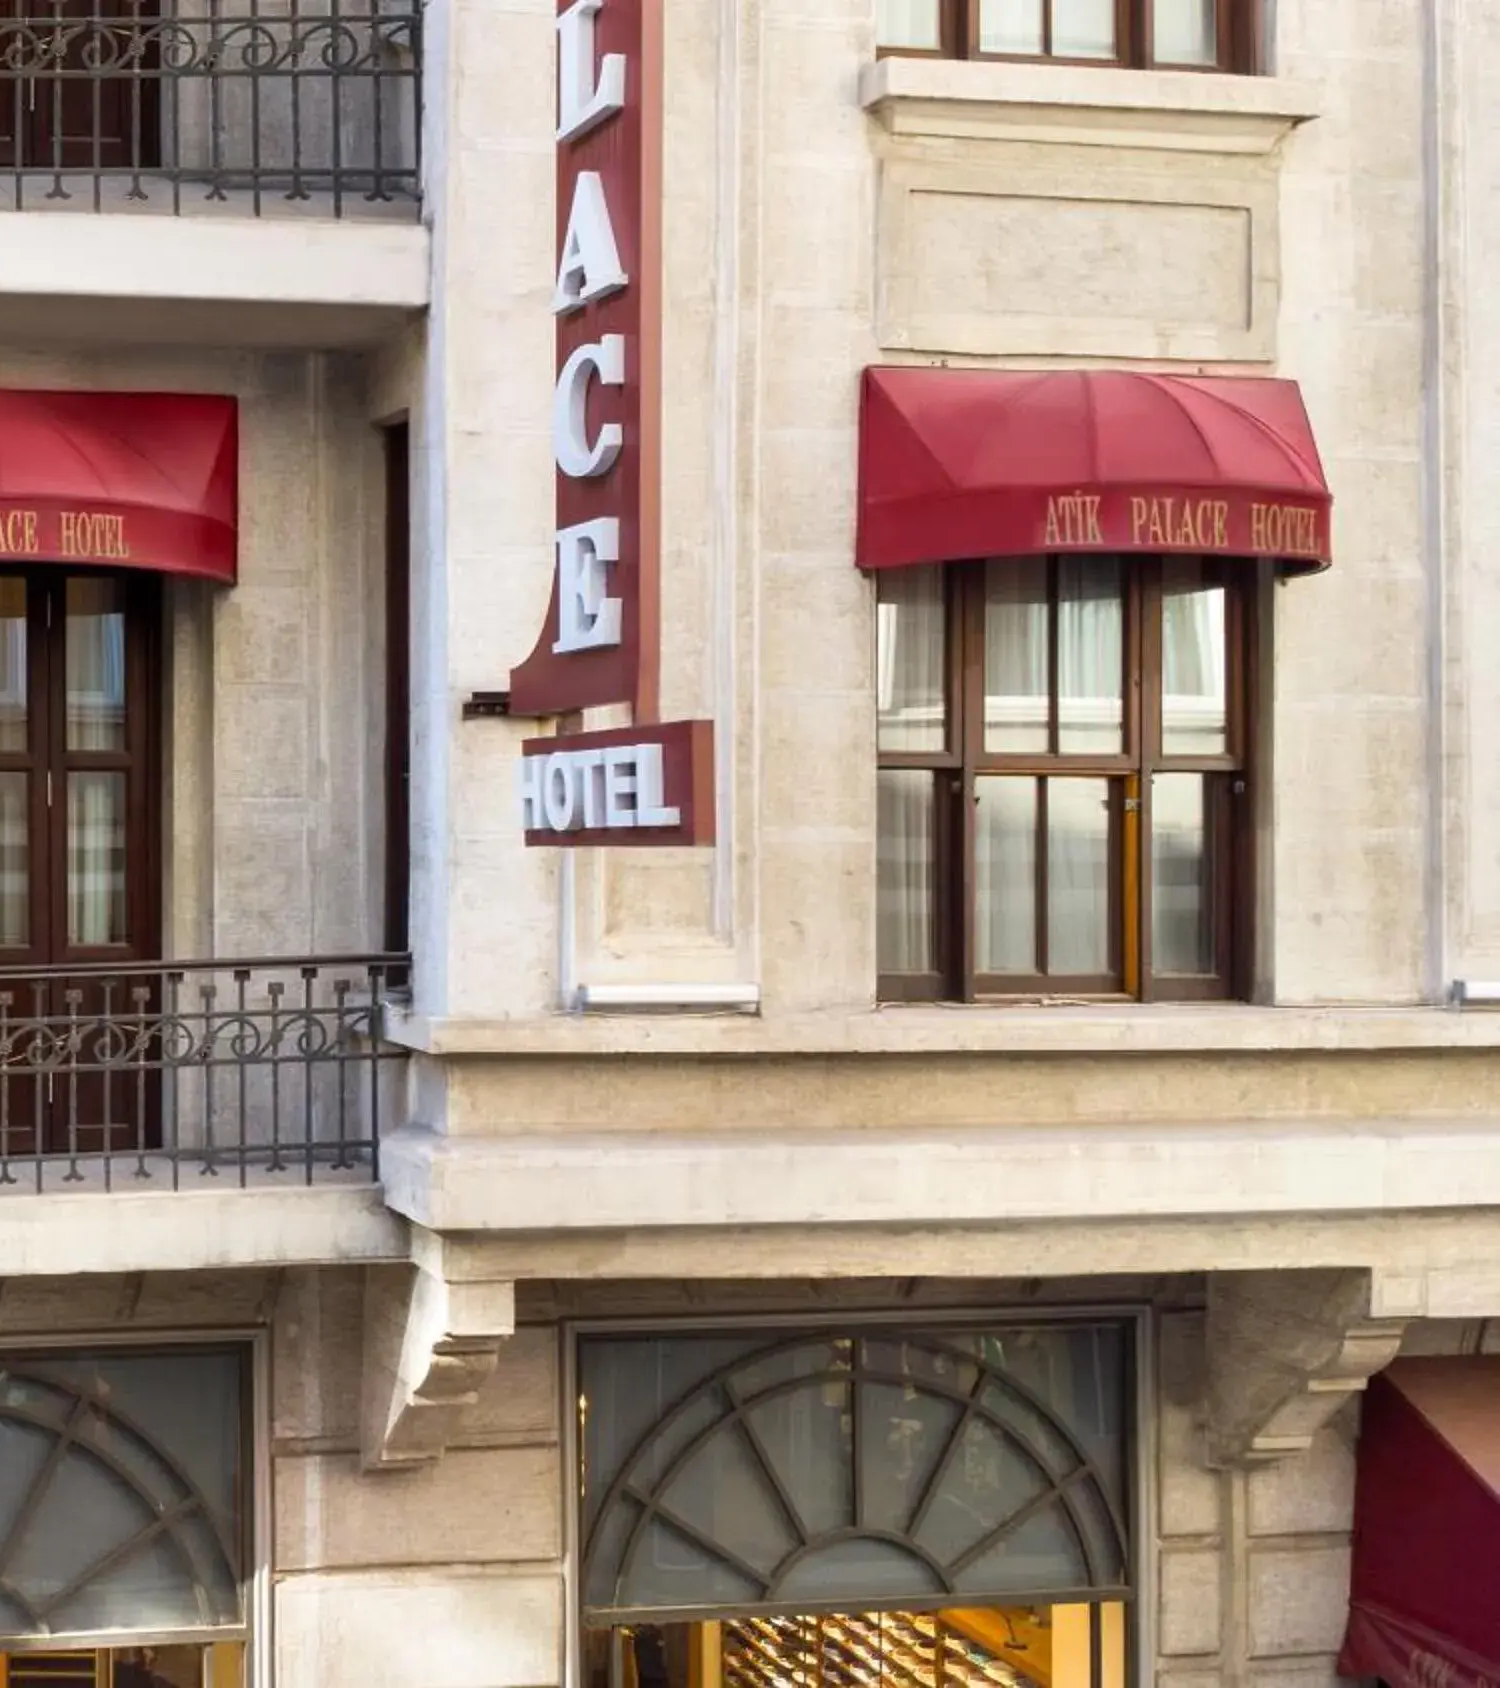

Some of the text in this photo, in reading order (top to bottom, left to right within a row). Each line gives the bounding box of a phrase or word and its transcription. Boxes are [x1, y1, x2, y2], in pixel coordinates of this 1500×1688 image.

[59, 511, 130, 559] HOTEL
[1130, 496, 1229, 548] PALACE
[1250, 502, 1321, 556] HOTEL
[514, 743, 681, 831] HOTEL
